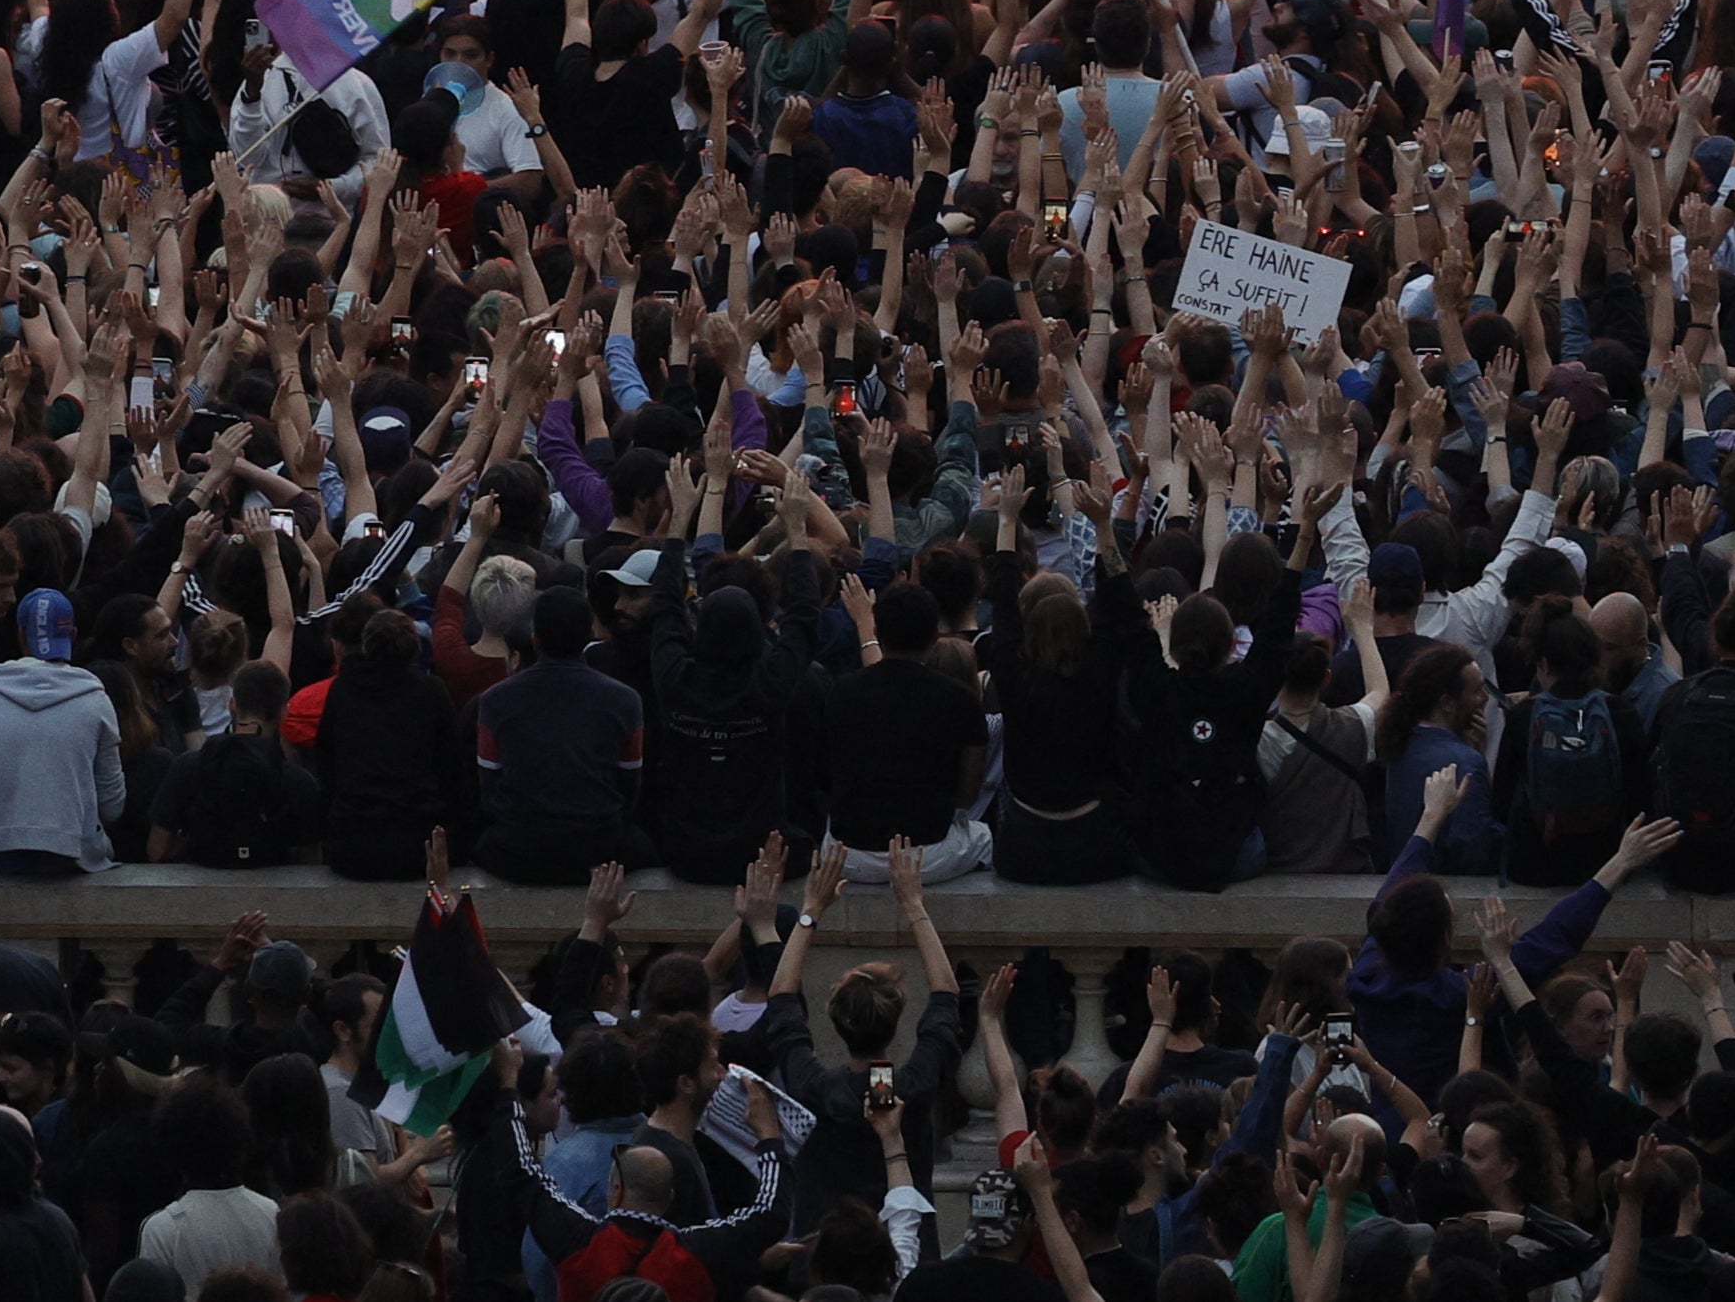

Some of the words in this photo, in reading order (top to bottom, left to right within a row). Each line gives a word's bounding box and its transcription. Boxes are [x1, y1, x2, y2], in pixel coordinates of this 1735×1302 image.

[1200, 223, 1239, 260] ÈRE
[1198, 269, 1219, 293] ÇA
[1177, 293, 1232, 317] CONSTAT
